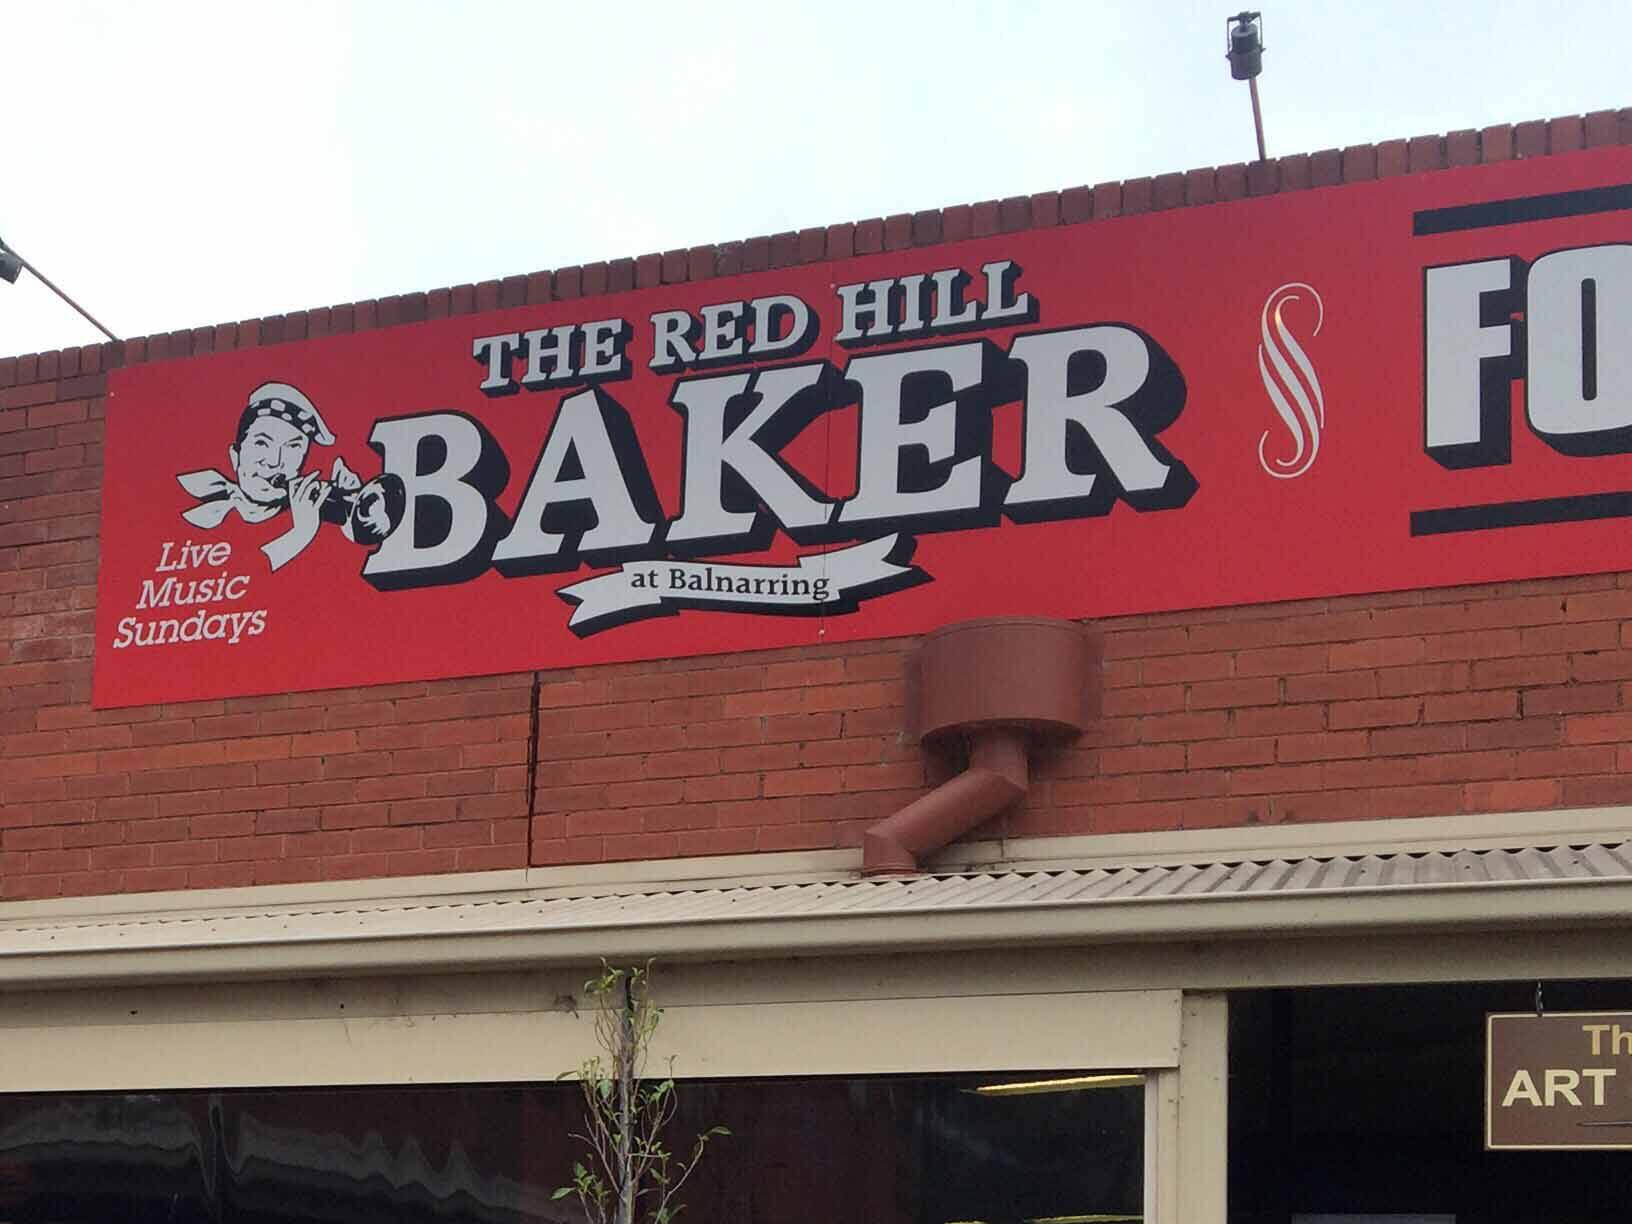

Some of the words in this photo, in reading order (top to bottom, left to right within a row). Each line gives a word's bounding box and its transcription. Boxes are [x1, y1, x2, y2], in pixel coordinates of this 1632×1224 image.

[472, 318, 627, 391] THE
[649, 294, 815, 370] RED
[834, 260, 1034, 344] HILL
[362, 324, 1183, 582] BAKER
[156, 540, 231, 572] Live
[136, 572, 250, 609] Music
[631, 570, 659, 589] at
[668, 568, 830, 601] Balnarring
[112, 609, 268, 648] Sundays
[1501, 1068, 1617, 1107] ART
